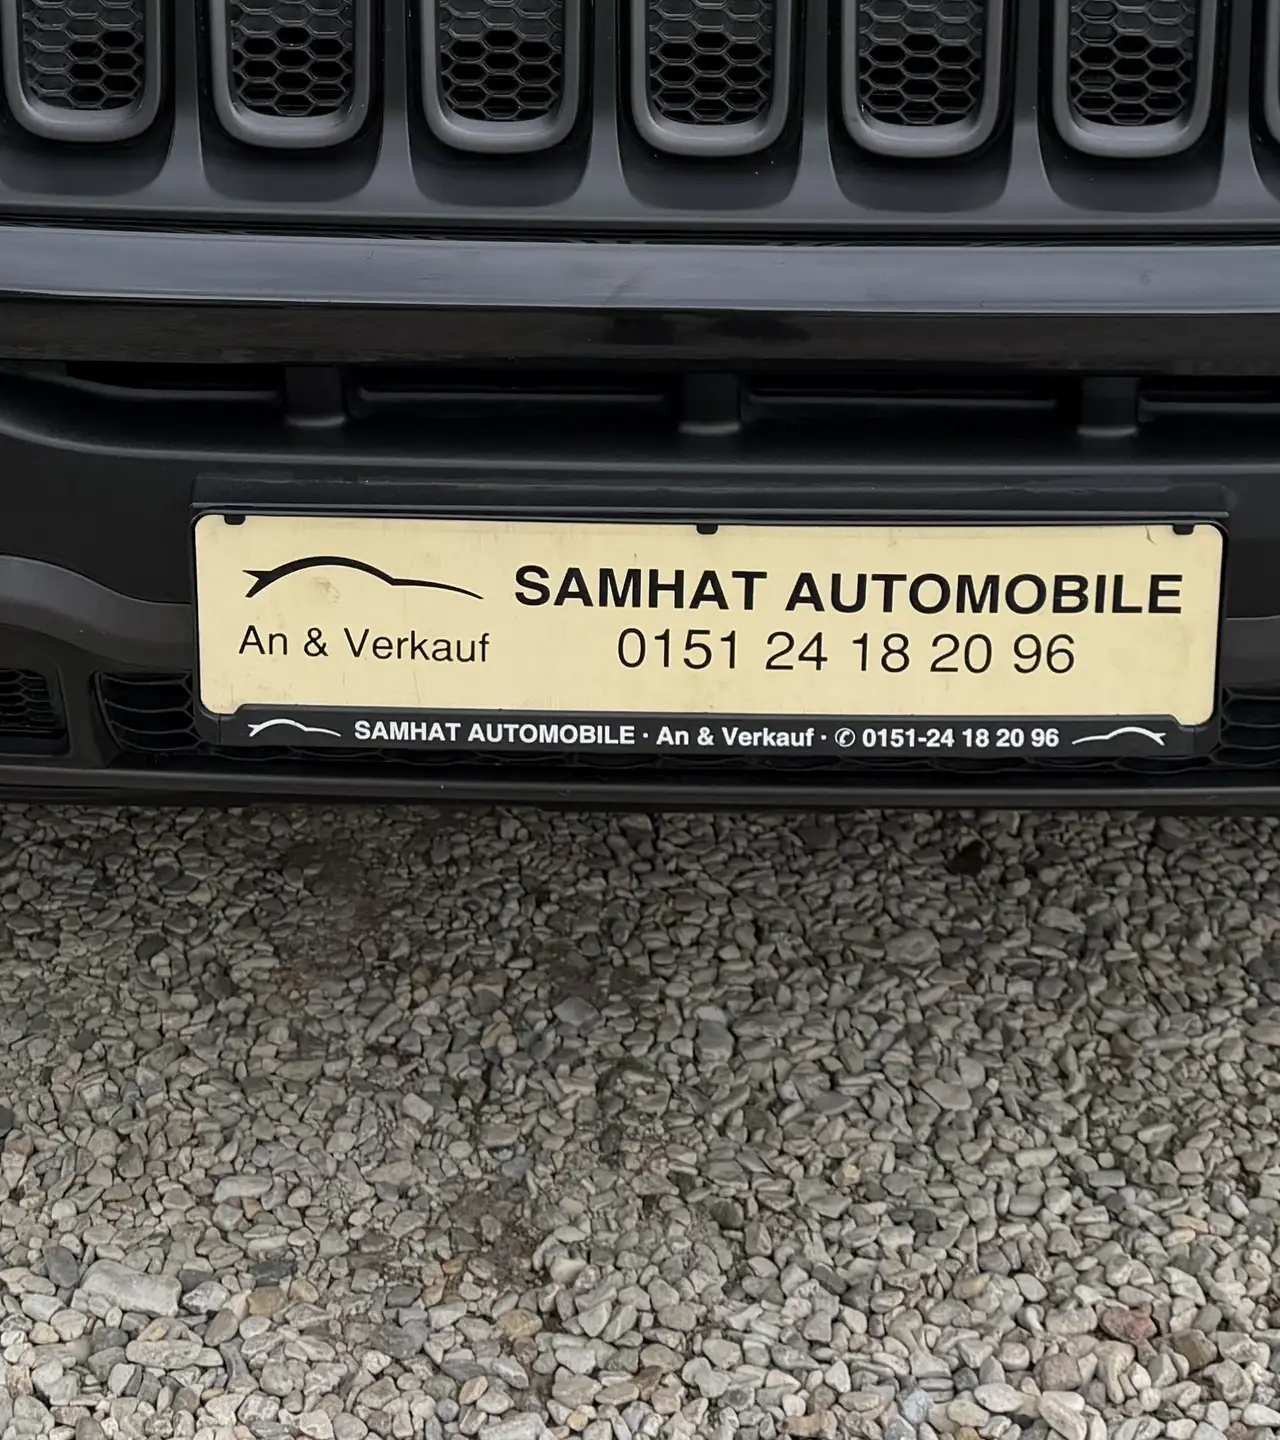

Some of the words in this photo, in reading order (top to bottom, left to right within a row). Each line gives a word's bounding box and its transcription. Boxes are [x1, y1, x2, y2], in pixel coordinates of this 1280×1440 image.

[515, 565, 767, 610] SAMHAT
[785, 572, 1183, 614] AUTOMOBILE
[239, 625, 288, 655] An
[304, 627, 329, 657] &
[344, 627, 490, 663] Verkauf
[618, 627, 736, 669] 0151
[765, 631, 828, 671] 24
[852, 633, 910, 673] 18
[930, 633, 992, 674] 20
[1013, 633, 1075, 674] 96
[354, 720, 462, 742] SAMHAT
[468, 723, 635, 744] AUTOMOBILE
[657, 726, 689, 746] An
[698, 726, 714, 746] &
[722, 726, 815, 747] Verkauf
[863, 728, 955, 748] 0151-24
[963, 728, 990, 748] 18
[996, 728, 1025, 748] 20
[1032, 728, 1060, 748] 96
